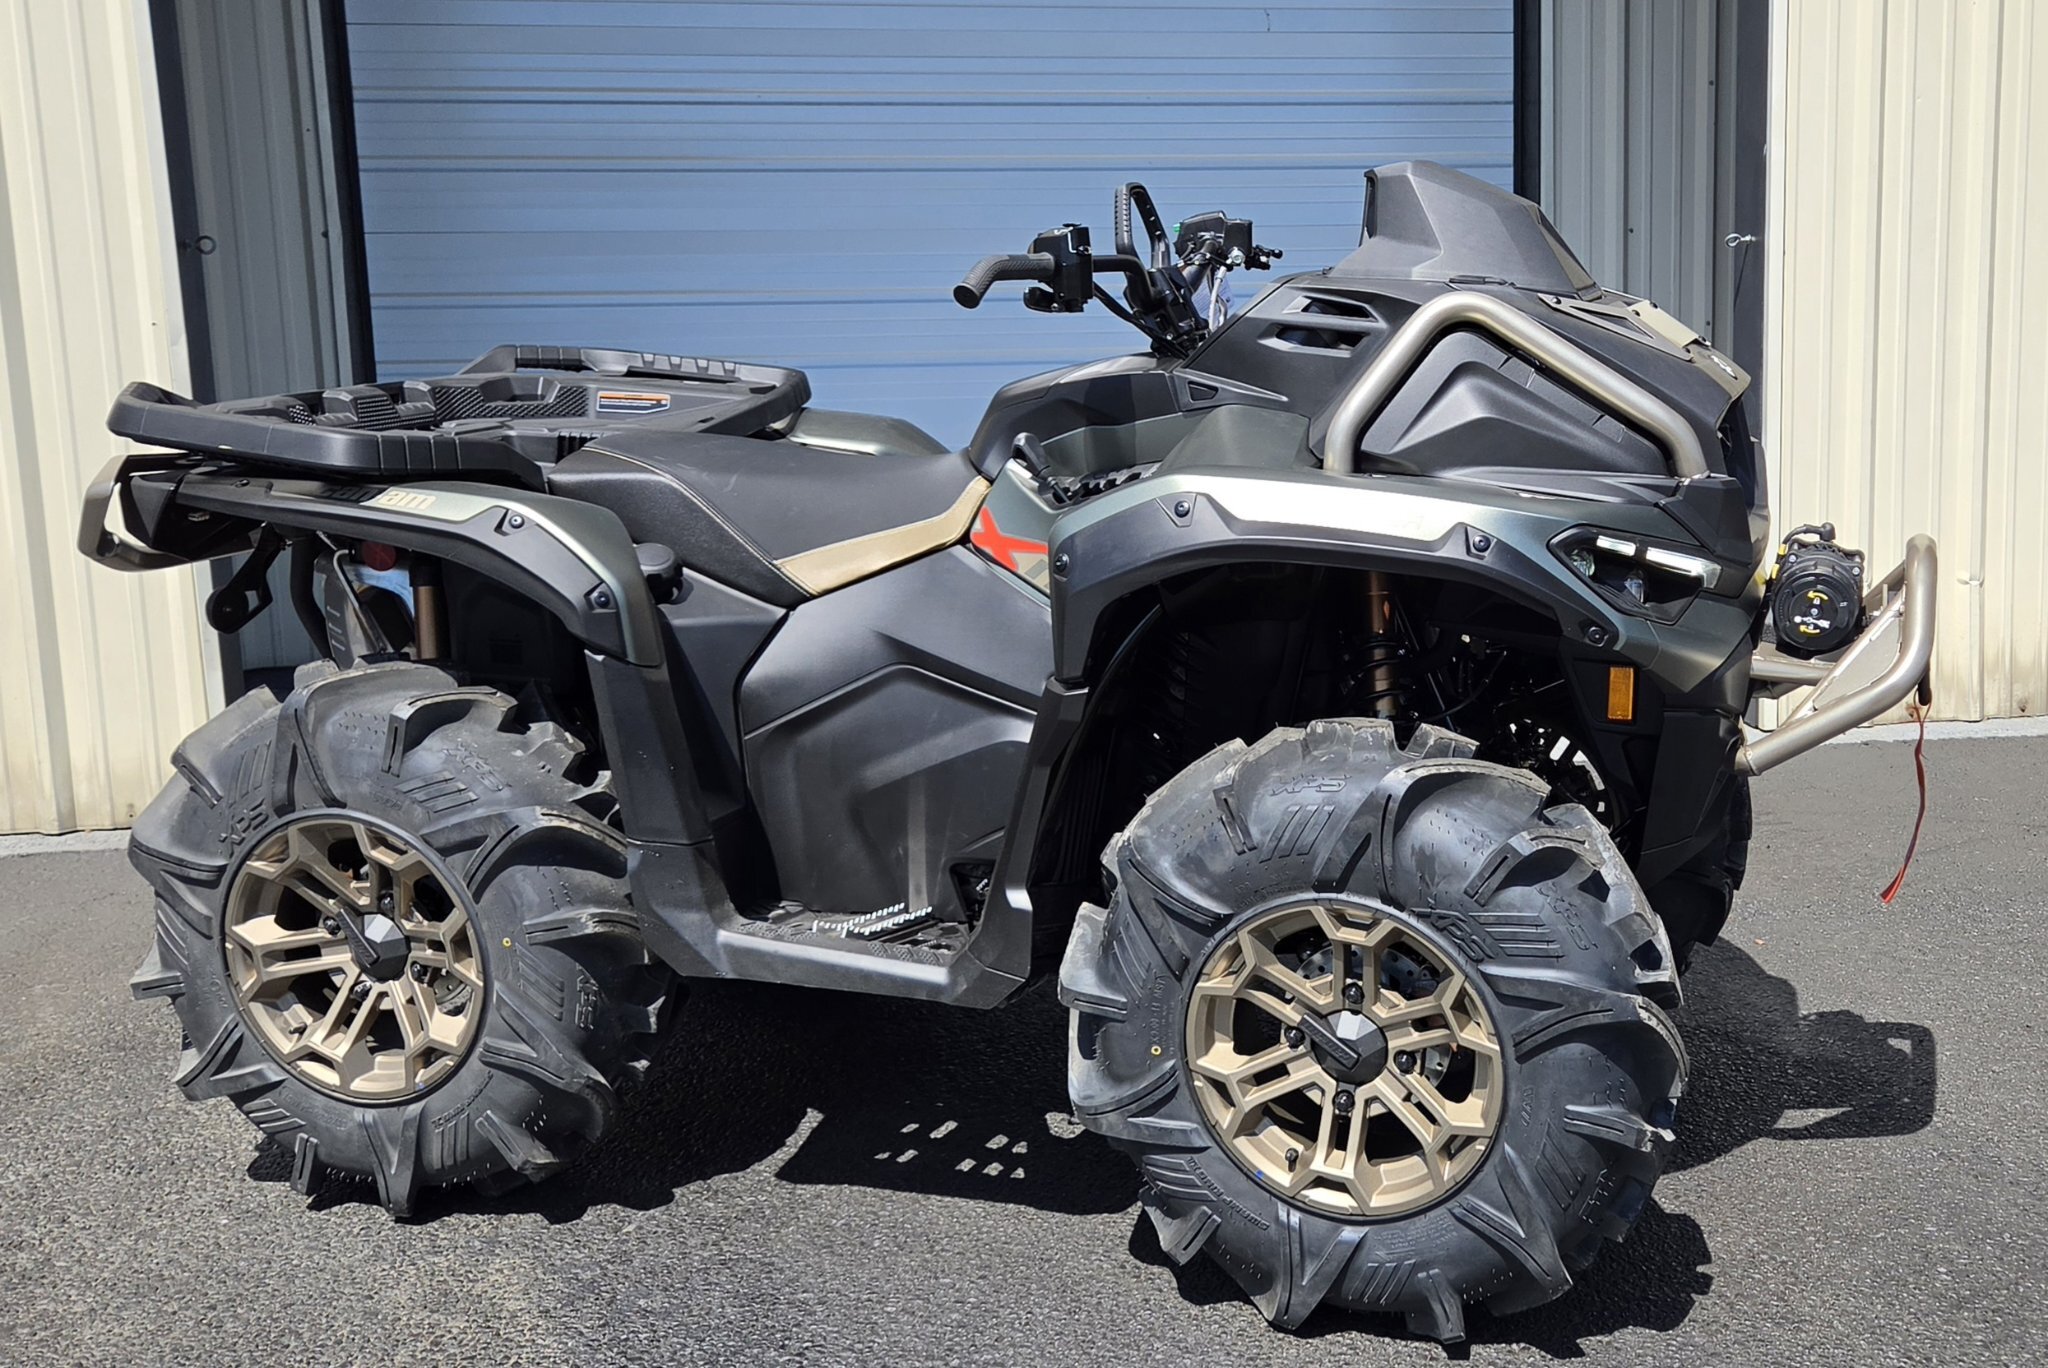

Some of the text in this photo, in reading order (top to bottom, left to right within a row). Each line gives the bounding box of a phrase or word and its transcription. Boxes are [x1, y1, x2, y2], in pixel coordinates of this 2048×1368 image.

[1268, 774, 1352, 796] XPS
[1410, 907, 1496, 963] XPS
[1534, 882, 1600, 951] XPS
[1221, 1195, 1271, 1232] SWAMP
